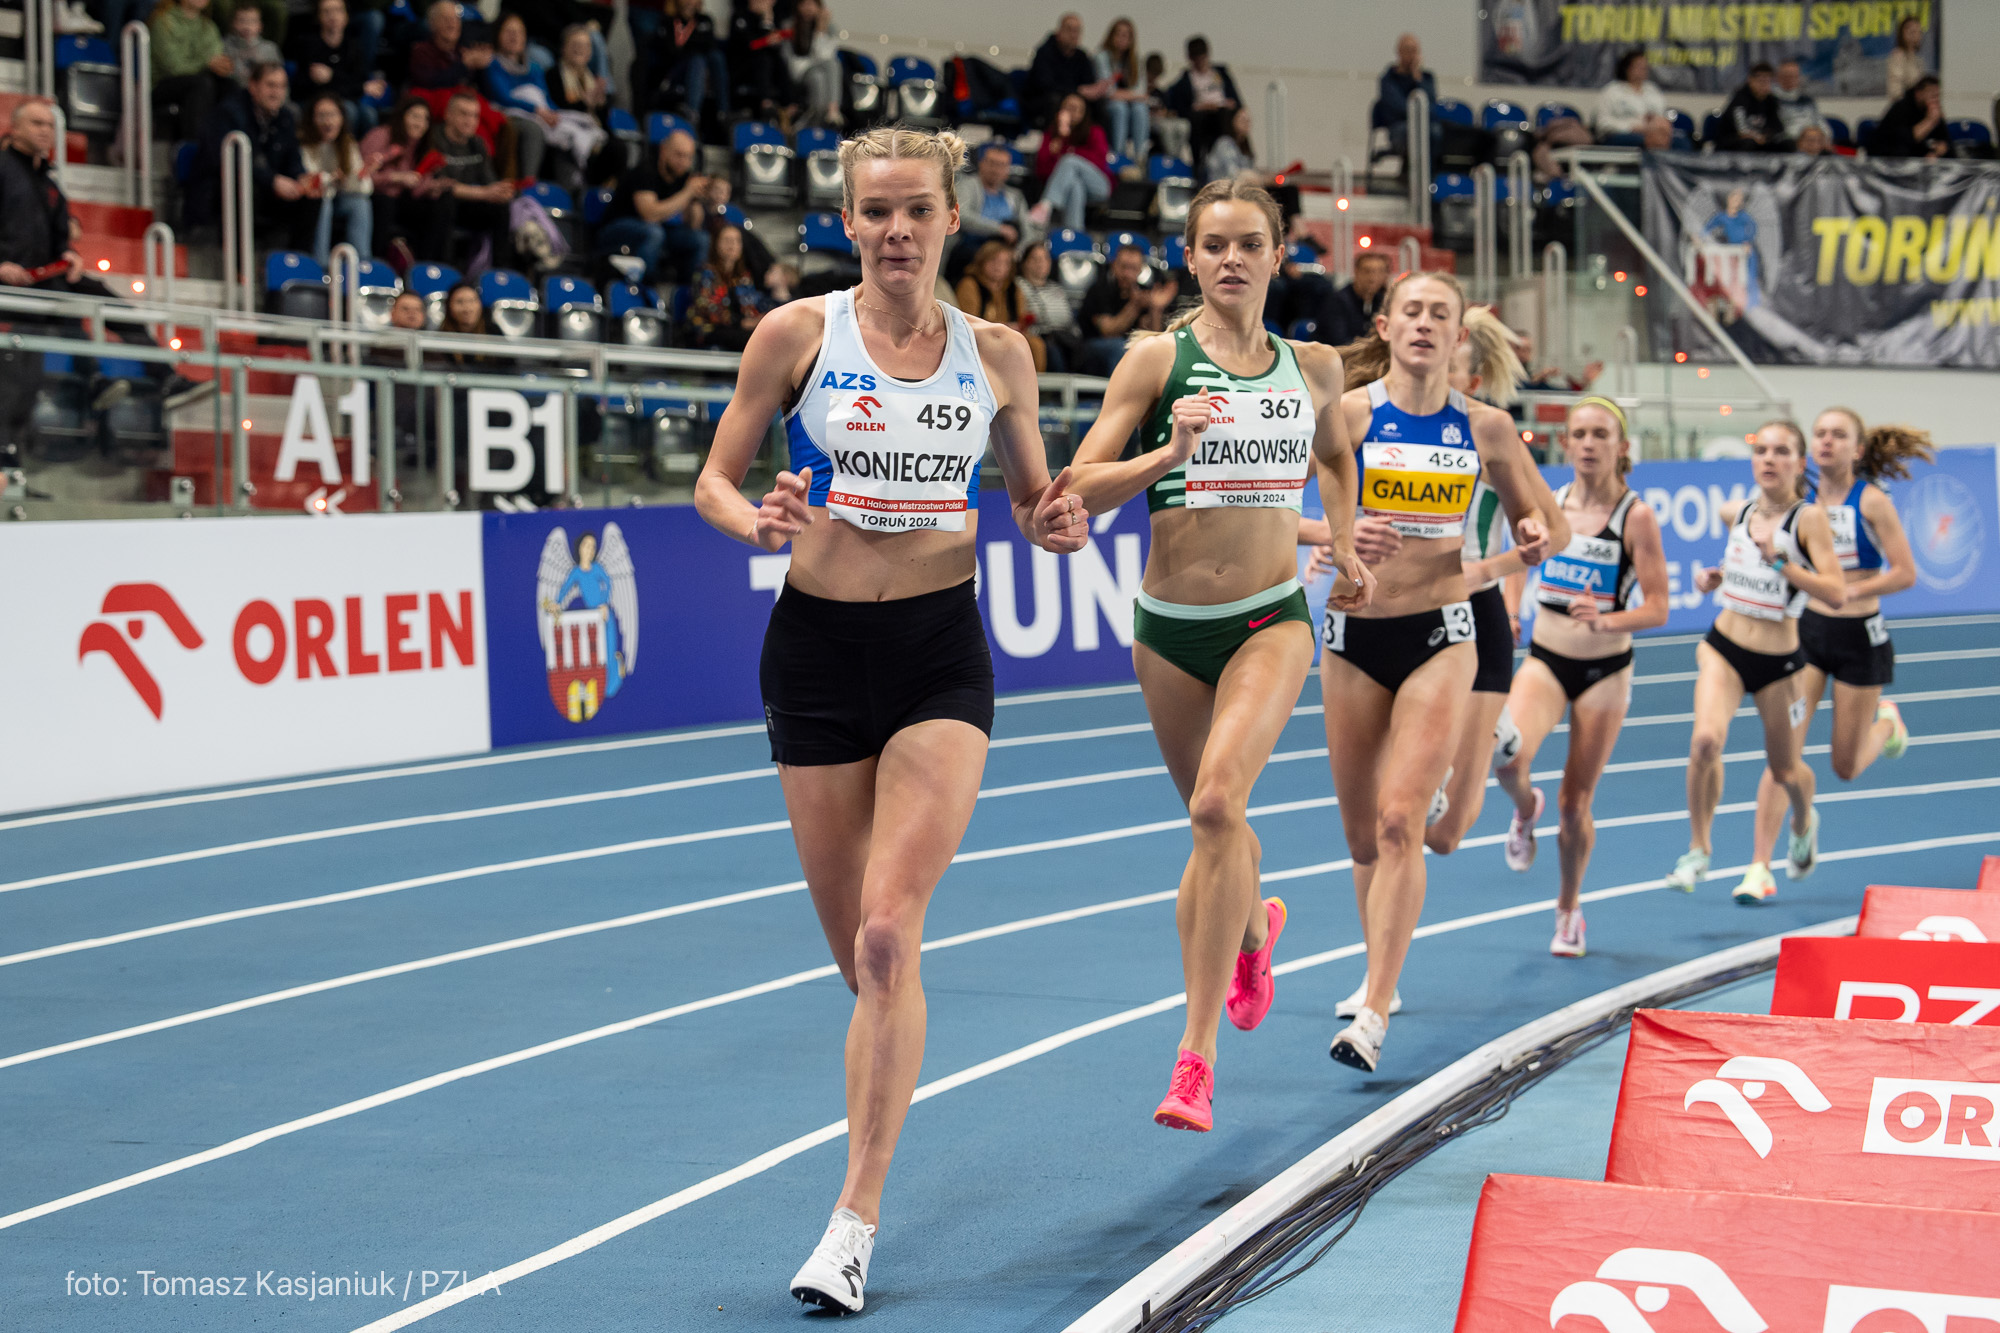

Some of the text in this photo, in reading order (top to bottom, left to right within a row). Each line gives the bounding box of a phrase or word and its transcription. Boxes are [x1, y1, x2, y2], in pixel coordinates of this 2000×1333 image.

[819, 371, 877, 391] AZS
[846, 404, 972, 432] ORLEN 459
[1210, 398, 1301, 424] RLEN 367
[274, 376, 372, 487] A1
[467, 387, 566, 494] B1
[1191, 439, 1307, 465] LIZAKOWSKA
[1429, 452, 1467, 468] 456
[833, 449, 972, 483] KONIECZEK
[1220, 491, 1286, 504] TORUŃ 2024
[1224, 481, 1252, 489] Halowe
[1373, 479, 1466, 504] GALANT
[833, 493, 964, 511] 68. PZLA Halowe Mistrzostwa Polski
[860, 513, 938, 528] TORUŃ 2024
[1544, 558, 1603, 588] BREZA
[1453, 607, 1472, 638] 3
[232, 589, 476, 686] ORLEN
